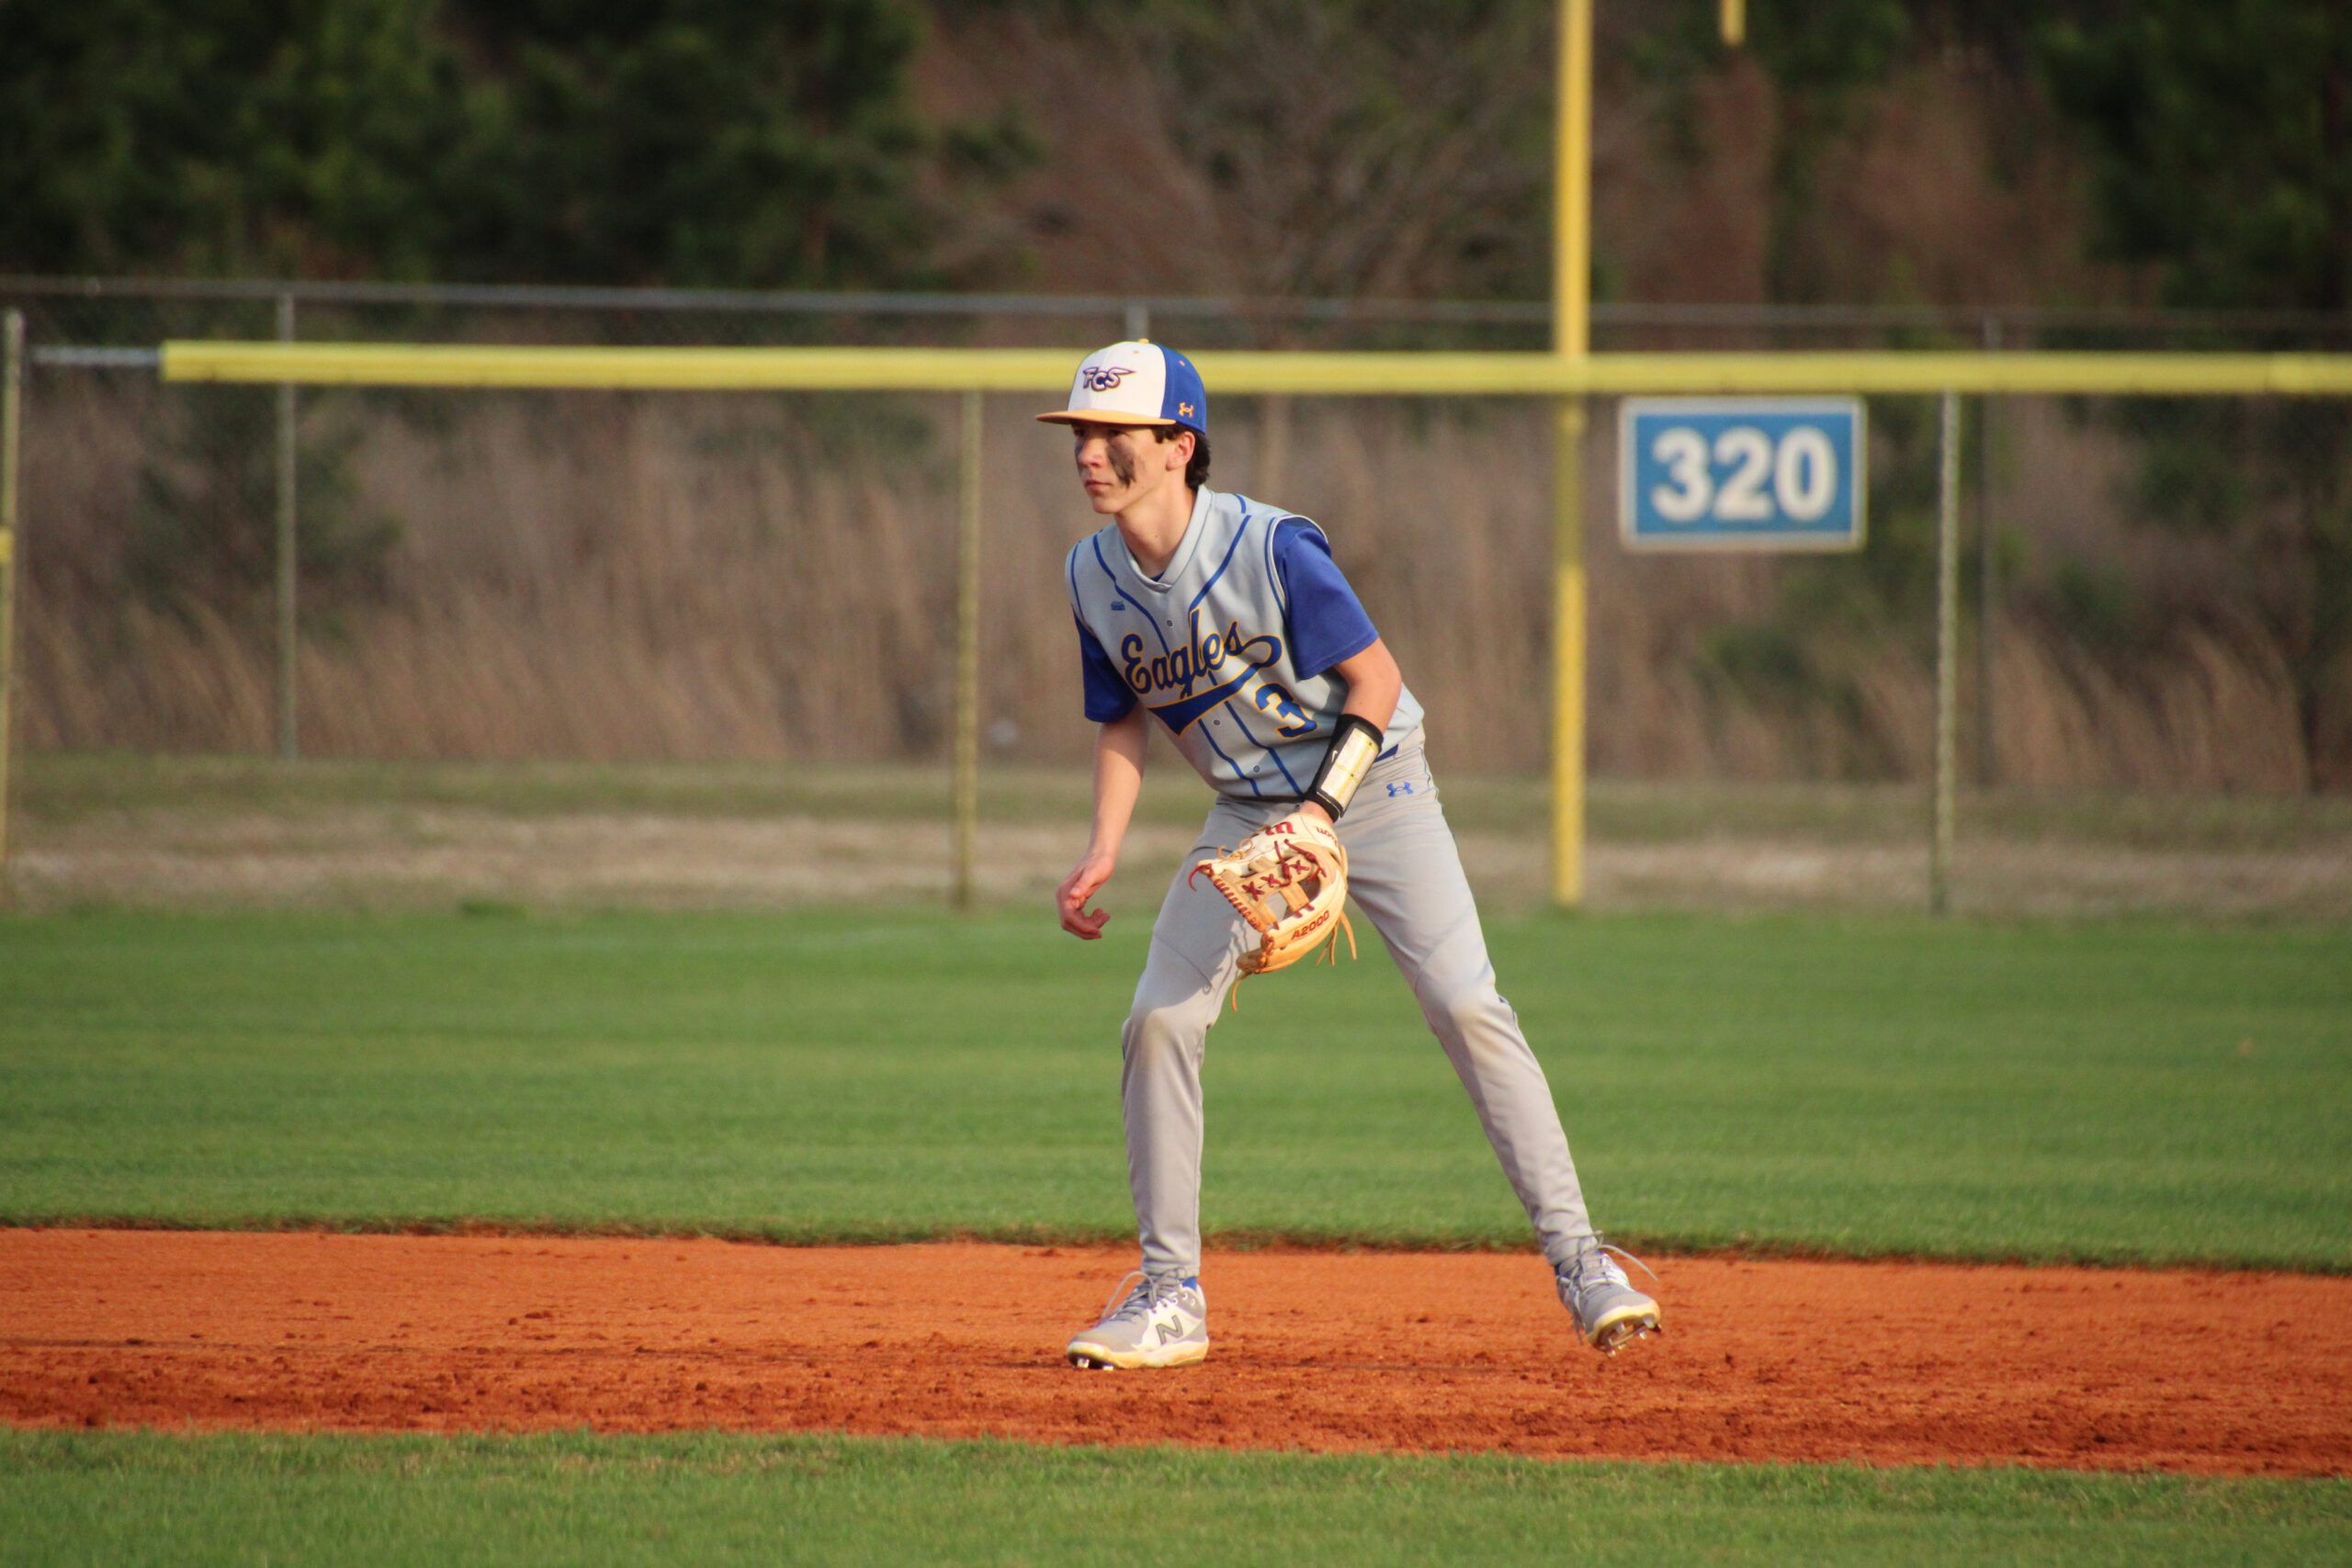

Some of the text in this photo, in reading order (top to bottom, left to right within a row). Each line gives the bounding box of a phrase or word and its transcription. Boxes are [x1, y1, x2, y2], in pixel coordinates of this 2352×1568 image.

[1082, 367, 1135, 391] FCS
[1653, 426, 1837, 521] 320
[1121, 606, 1282, 702] Eagles
[1253, 682, 1318, 738] 3
[1292, 910, 1329, 941] A2000
[1157, 1315, 1183, 1345] N
